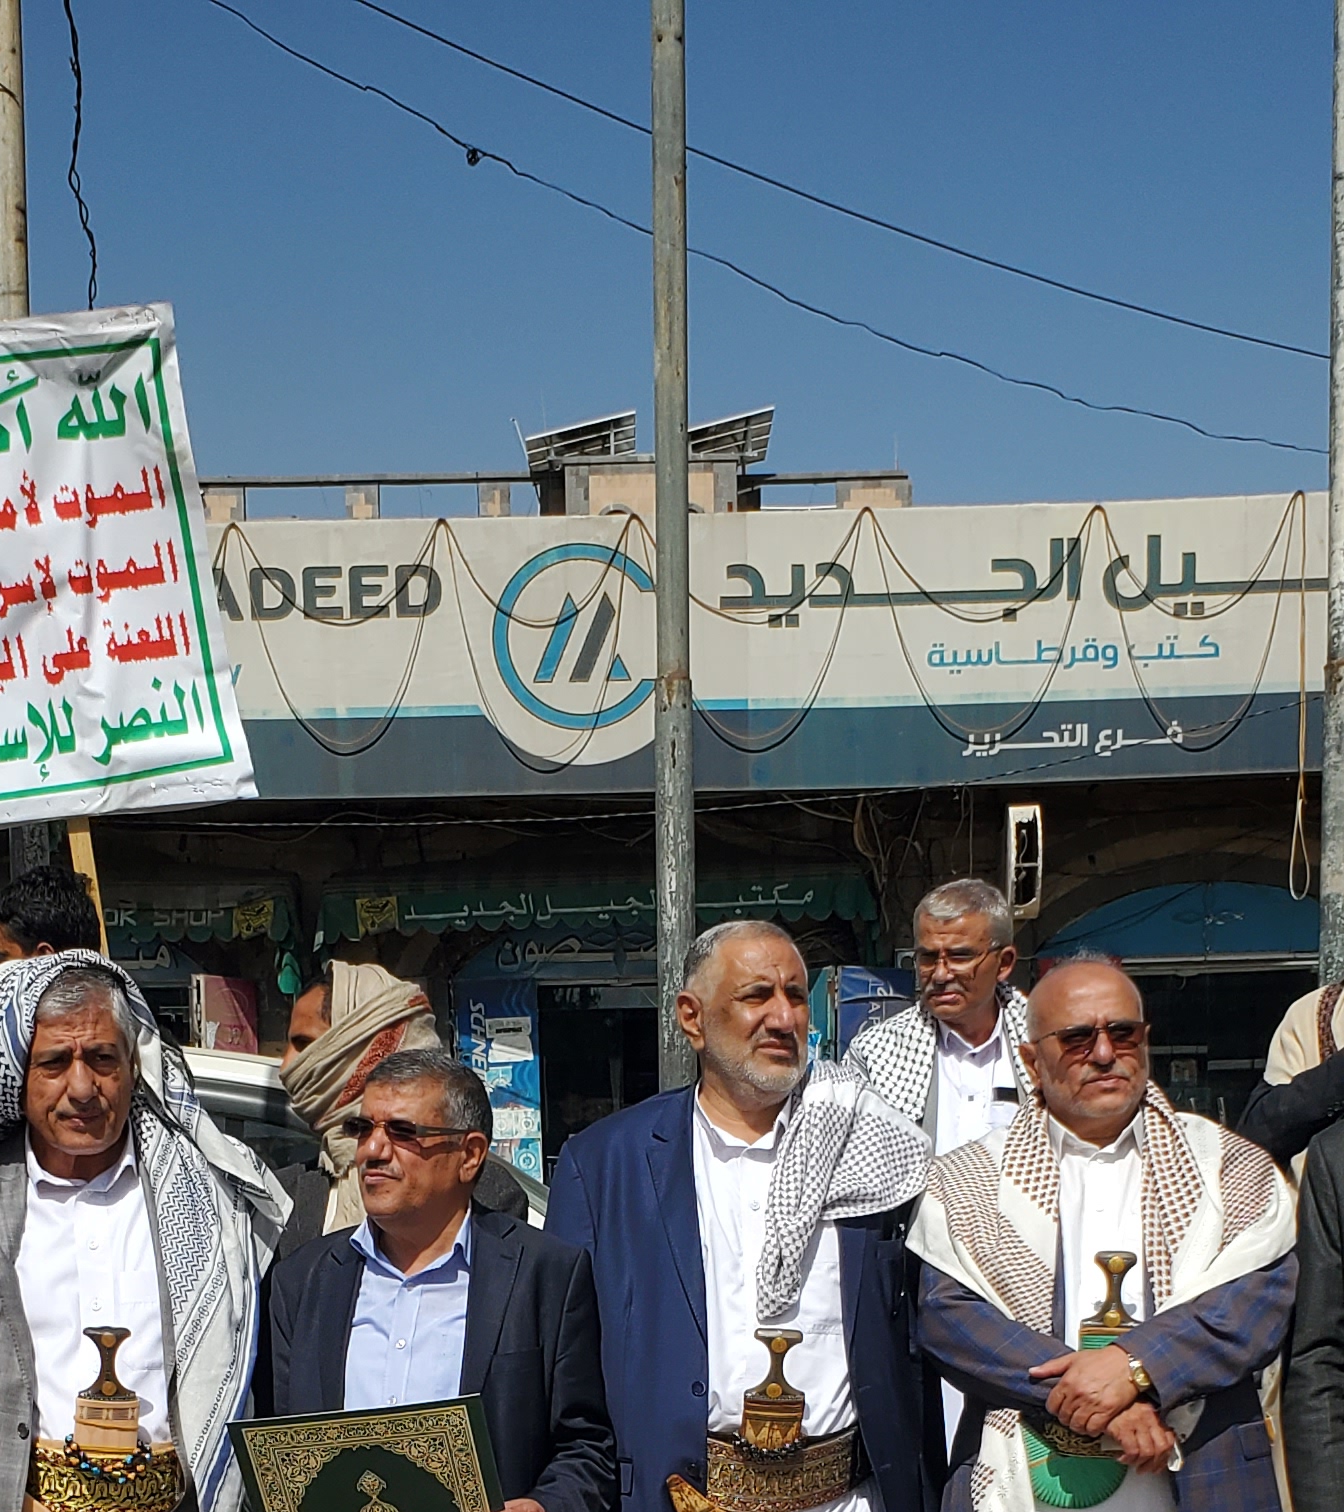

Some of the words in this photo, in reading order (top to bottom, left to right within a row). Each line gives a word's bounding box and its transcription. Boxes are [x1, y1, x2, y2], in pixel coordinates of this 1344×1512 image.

[57, 369, 152, 441] الله
[53, 463, 166, 530] الموت
[67, 537, 179, 603] الموت
[719, 537, 1081, 628] الجديد
[103, 609, 191, 664] اللعنة
[1131, 634, 1220, 668] كتب
[41, 625, 91, 686] على
[926, 638, 1119, 675] وقرطاسية
[92, 677, 205, 766] النصر
[962, 723, 1088, 757] التحرير
[1094, 720, 1183, 757] فرع
[404, 892, 534, 926] الجديد
[536, 889, 656, 921] لجيل
[695, 883, 814, 915] مكتب
[153, 910, 224, 927] SHOP
